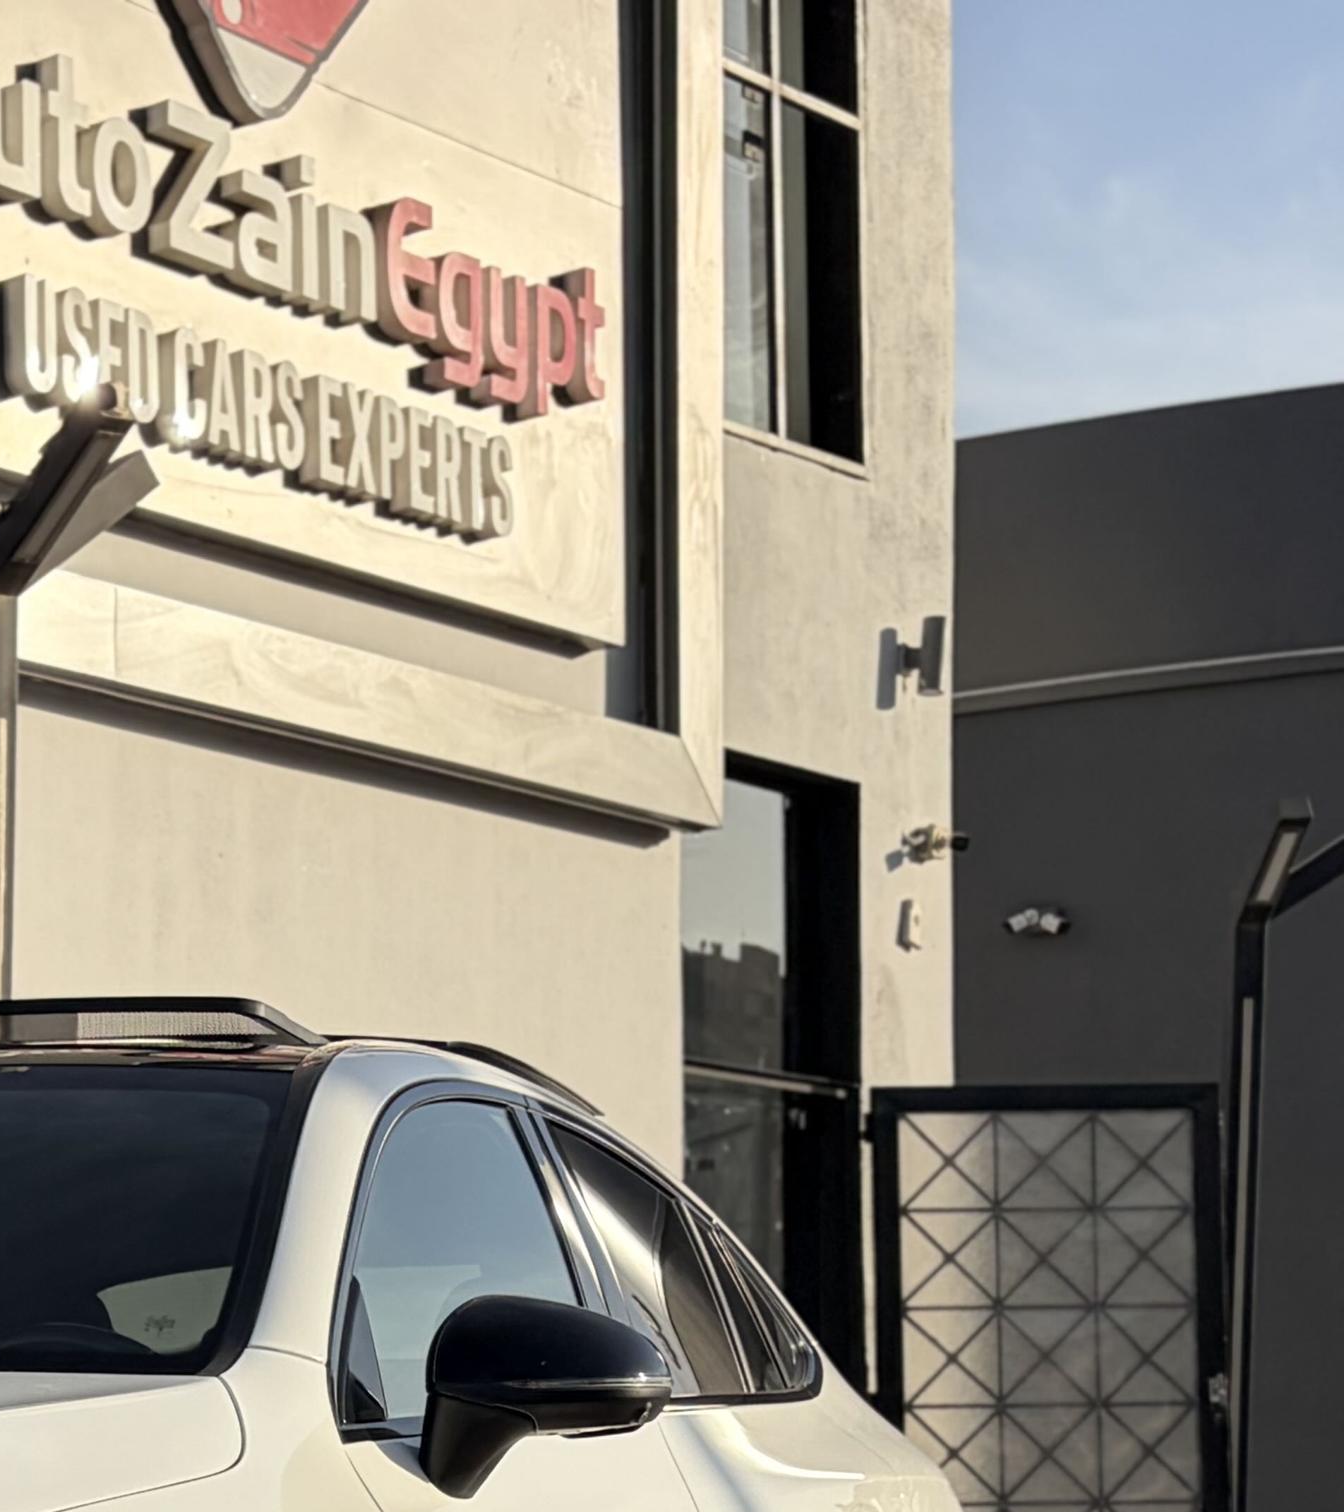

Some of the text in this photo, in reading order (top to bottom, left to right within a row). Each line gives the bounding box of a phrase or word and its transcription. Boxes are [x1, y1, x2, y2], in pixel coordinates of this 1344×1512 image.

[147, 98, 376, 323] Zain
[382, 197, 605, 418] Egypt
[18, 272, 514, 540] USED CARS EXPERTS
